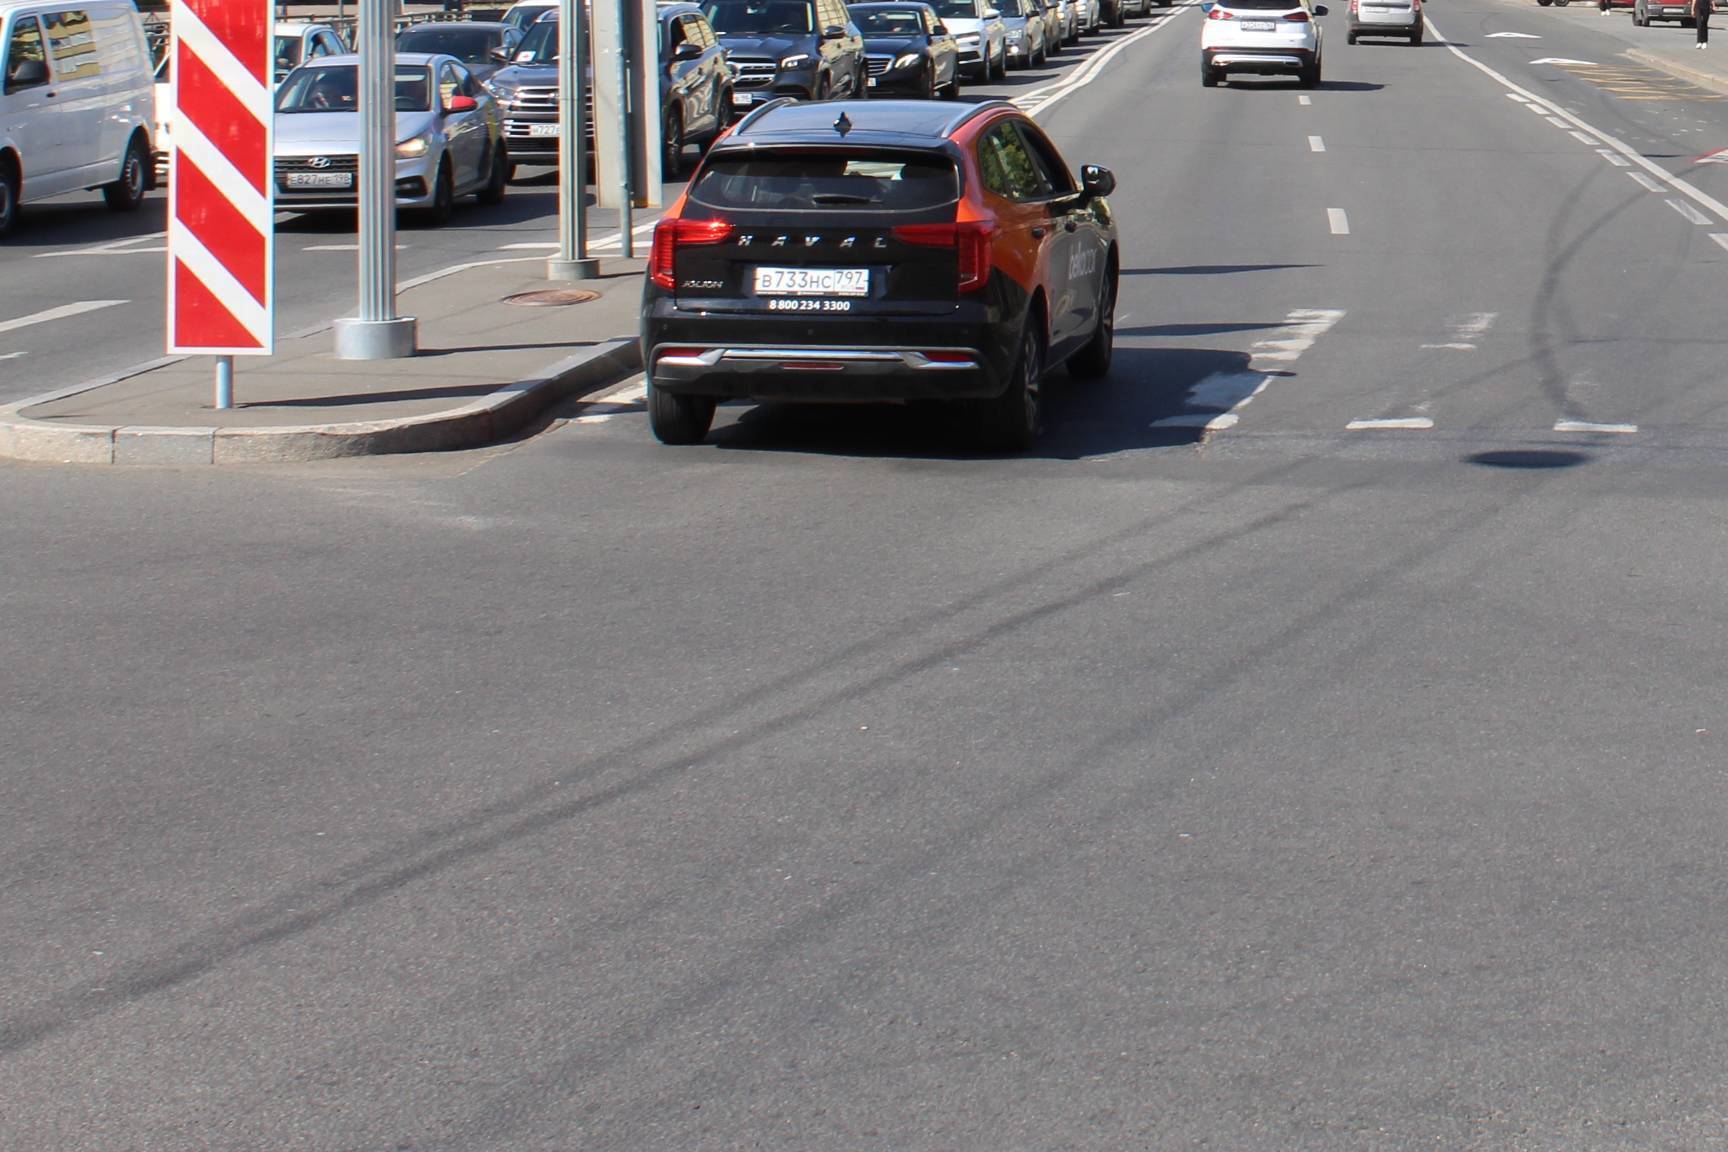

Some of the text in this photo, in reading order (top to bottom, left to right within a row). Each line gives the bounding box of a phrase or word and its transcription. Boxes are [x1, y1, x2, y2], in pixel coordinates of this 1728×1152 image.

[738, 235, 888, 248] HAVAL
[768, 299, 850, 311] 8 800 234 3300
